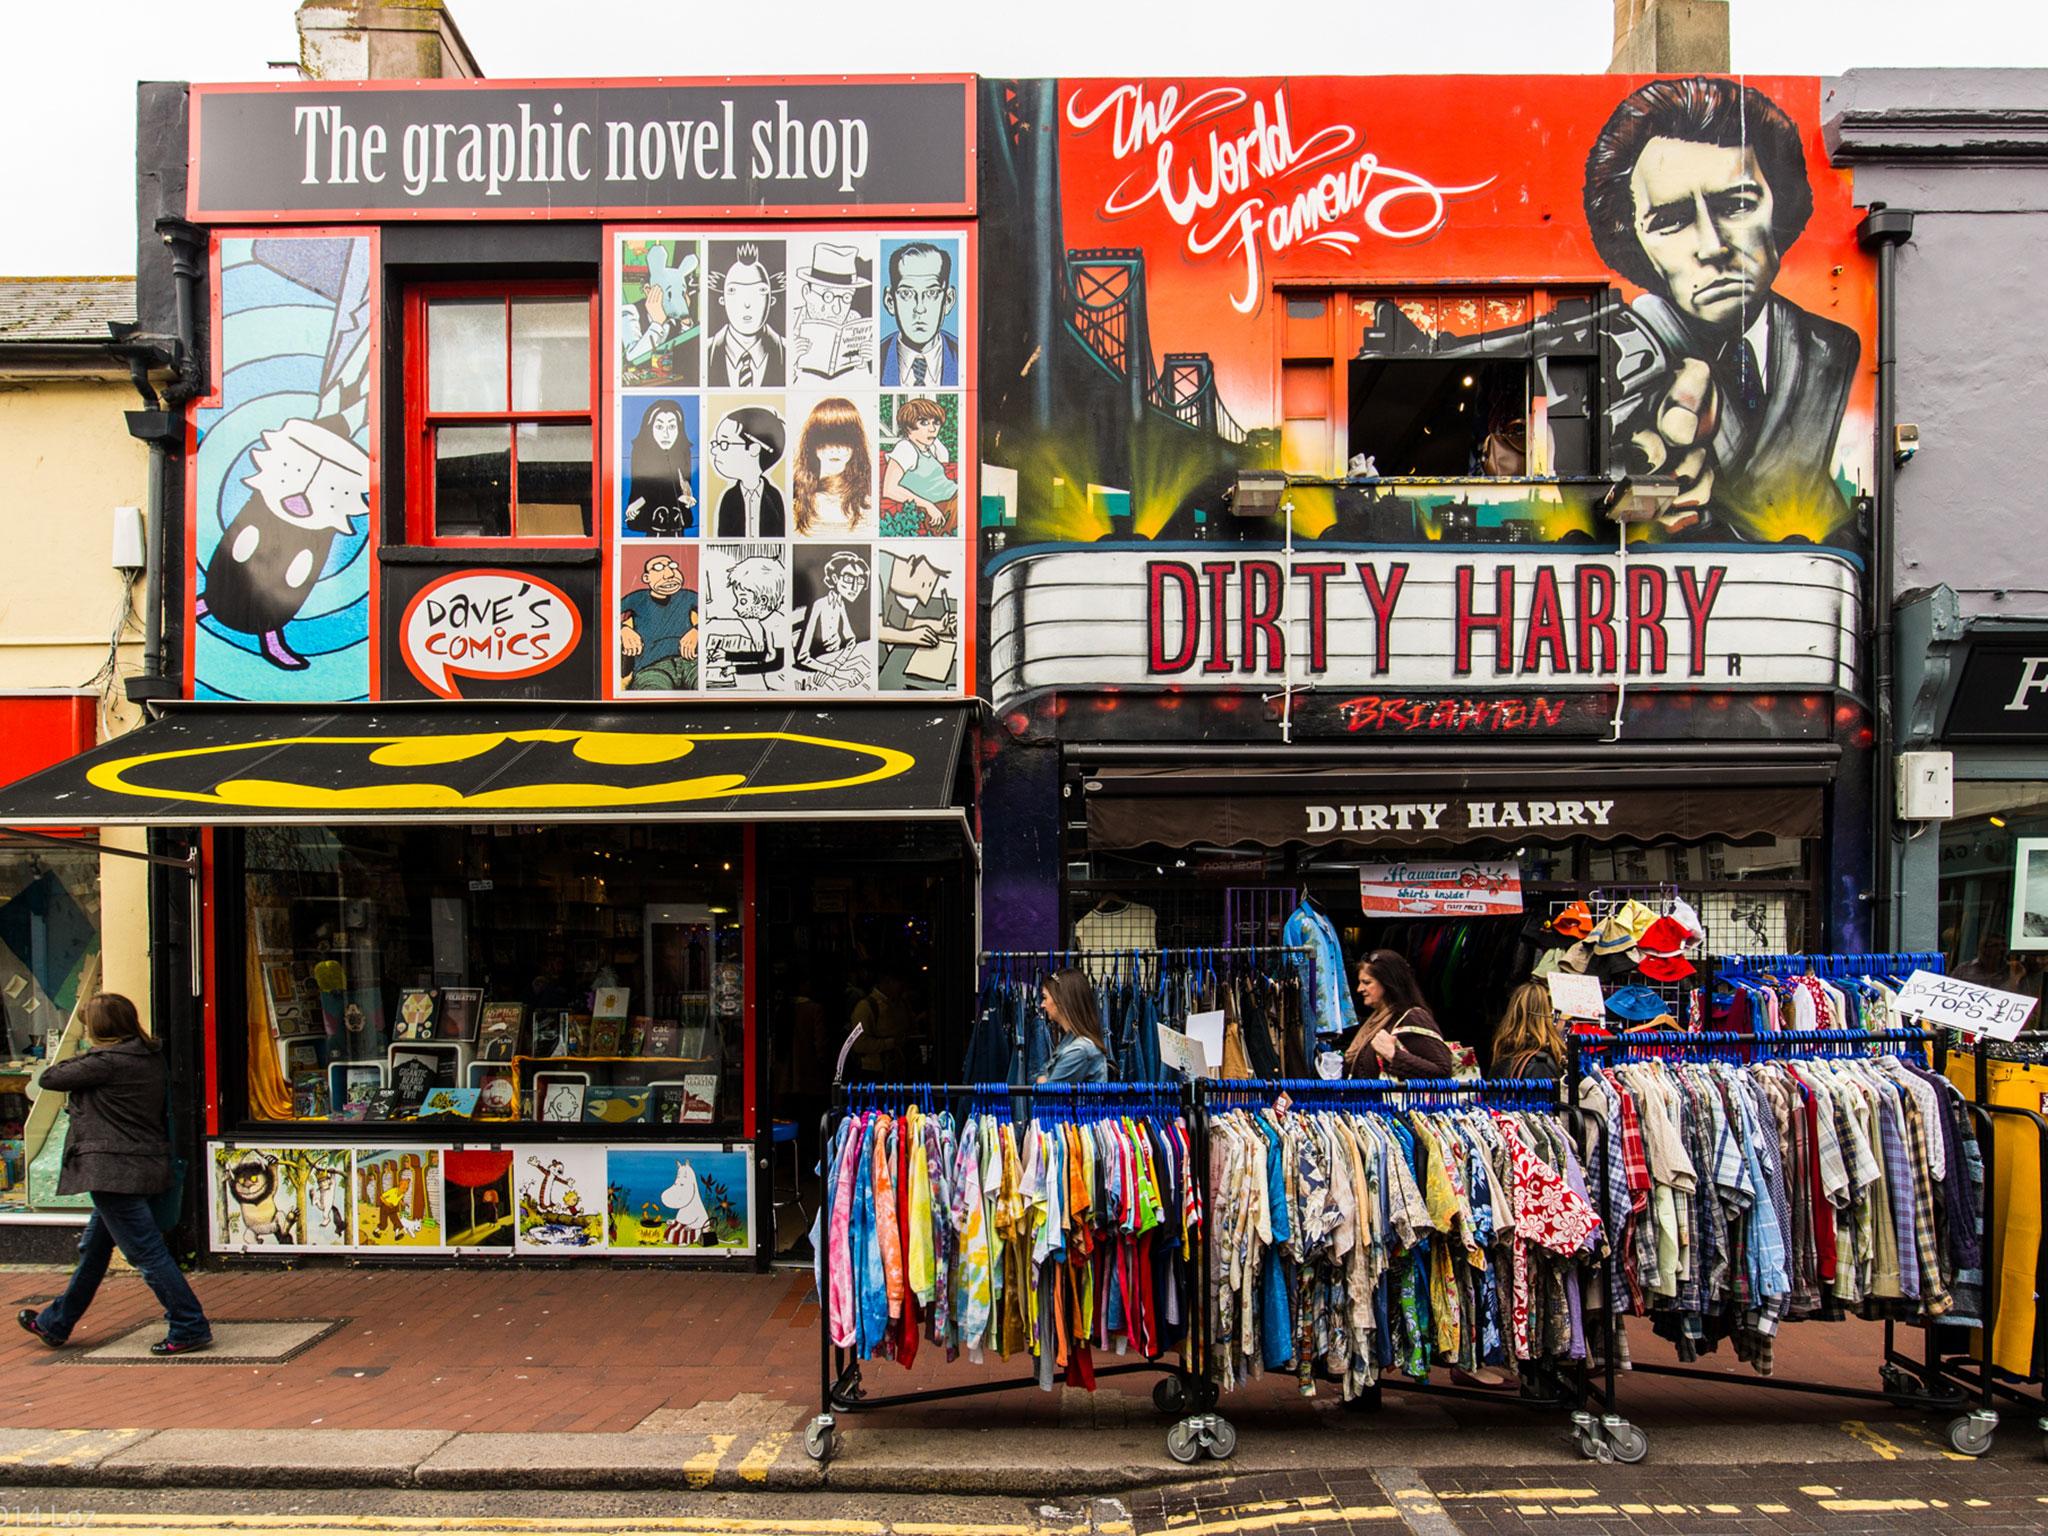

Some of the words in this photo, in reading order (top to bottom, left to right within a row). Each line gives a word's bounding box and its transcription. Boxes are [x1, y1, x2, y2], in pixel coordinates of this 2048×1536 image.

[1067, 84, 1247, 159] The
[295, 105, 387, 184] The
[403, 103, 592, 196] graphic
[605, 101, 737, 180] novel
[751, 100, 869, 192] shop
[1105, 88, 1355, 225] World
[1188, 153, 1498, 313] Famous
[1146, 560, 1409, 676] DIRTY
[1454, 562, 1727, 677] HARRY
[1727, 652, 1742, 676] R
[2004, 657, 2048, 710] F
[1338, 695, 1566, 732] BRIGHTON
[1926, 771, 1935, 781] 7
[1306, 803, 1447, 833] DIRTY
[1468, 800, 1614, 828] HARRY
[1384, 865, 1459, 882] Hawaiian
[1435, 888, 1470, 899] inside!
[1925, 994, 1984, 1018] TOPS
[1987, 999, 2029, 1024] £15
[1931, 981, 1996, 1007] AZTEK
[399, 1068, 428, 1078] GIGANTIC
